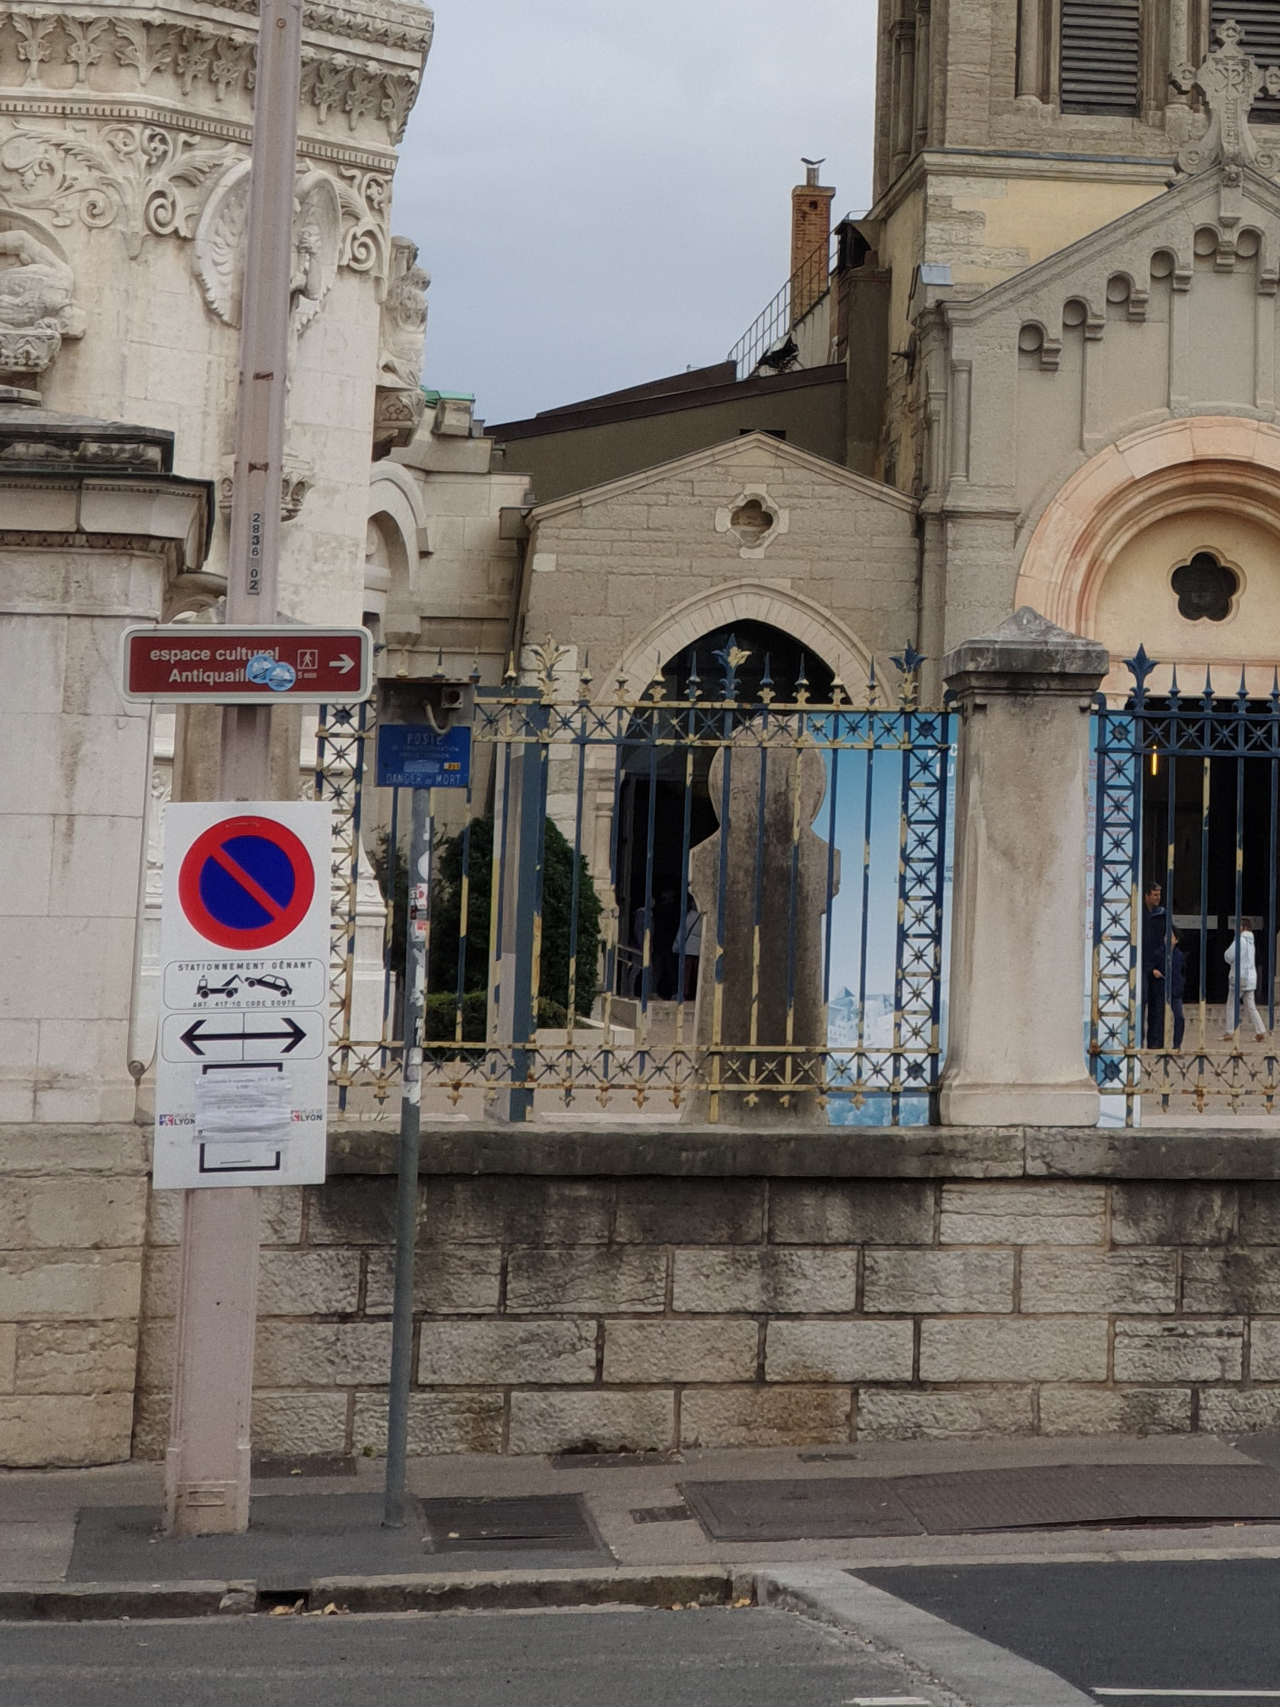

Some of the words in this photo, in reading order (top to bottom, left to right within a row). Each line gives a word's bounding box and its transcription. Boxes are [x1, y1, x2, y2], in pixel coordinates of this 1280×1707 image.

[251, 513, 261, 557] 2836
[249, 568, 259, 590] 02
[150, 648, 211, 664] espace
[215, 646, 279, 661] culturel
[168, 668, 251, 685] Antiquaill
[407, 733, 443, 745] POSTE
[386, 774, 422, 784] DANGER
[435, 774, 461, 785] MORT
[178, 962, 265, 971] STATIONNEMENT
[271, 960, 313, 970] GÊNANT
[174, 1117, 196, 1126] LYON
[300, 1114, 323, 1122] LYON
